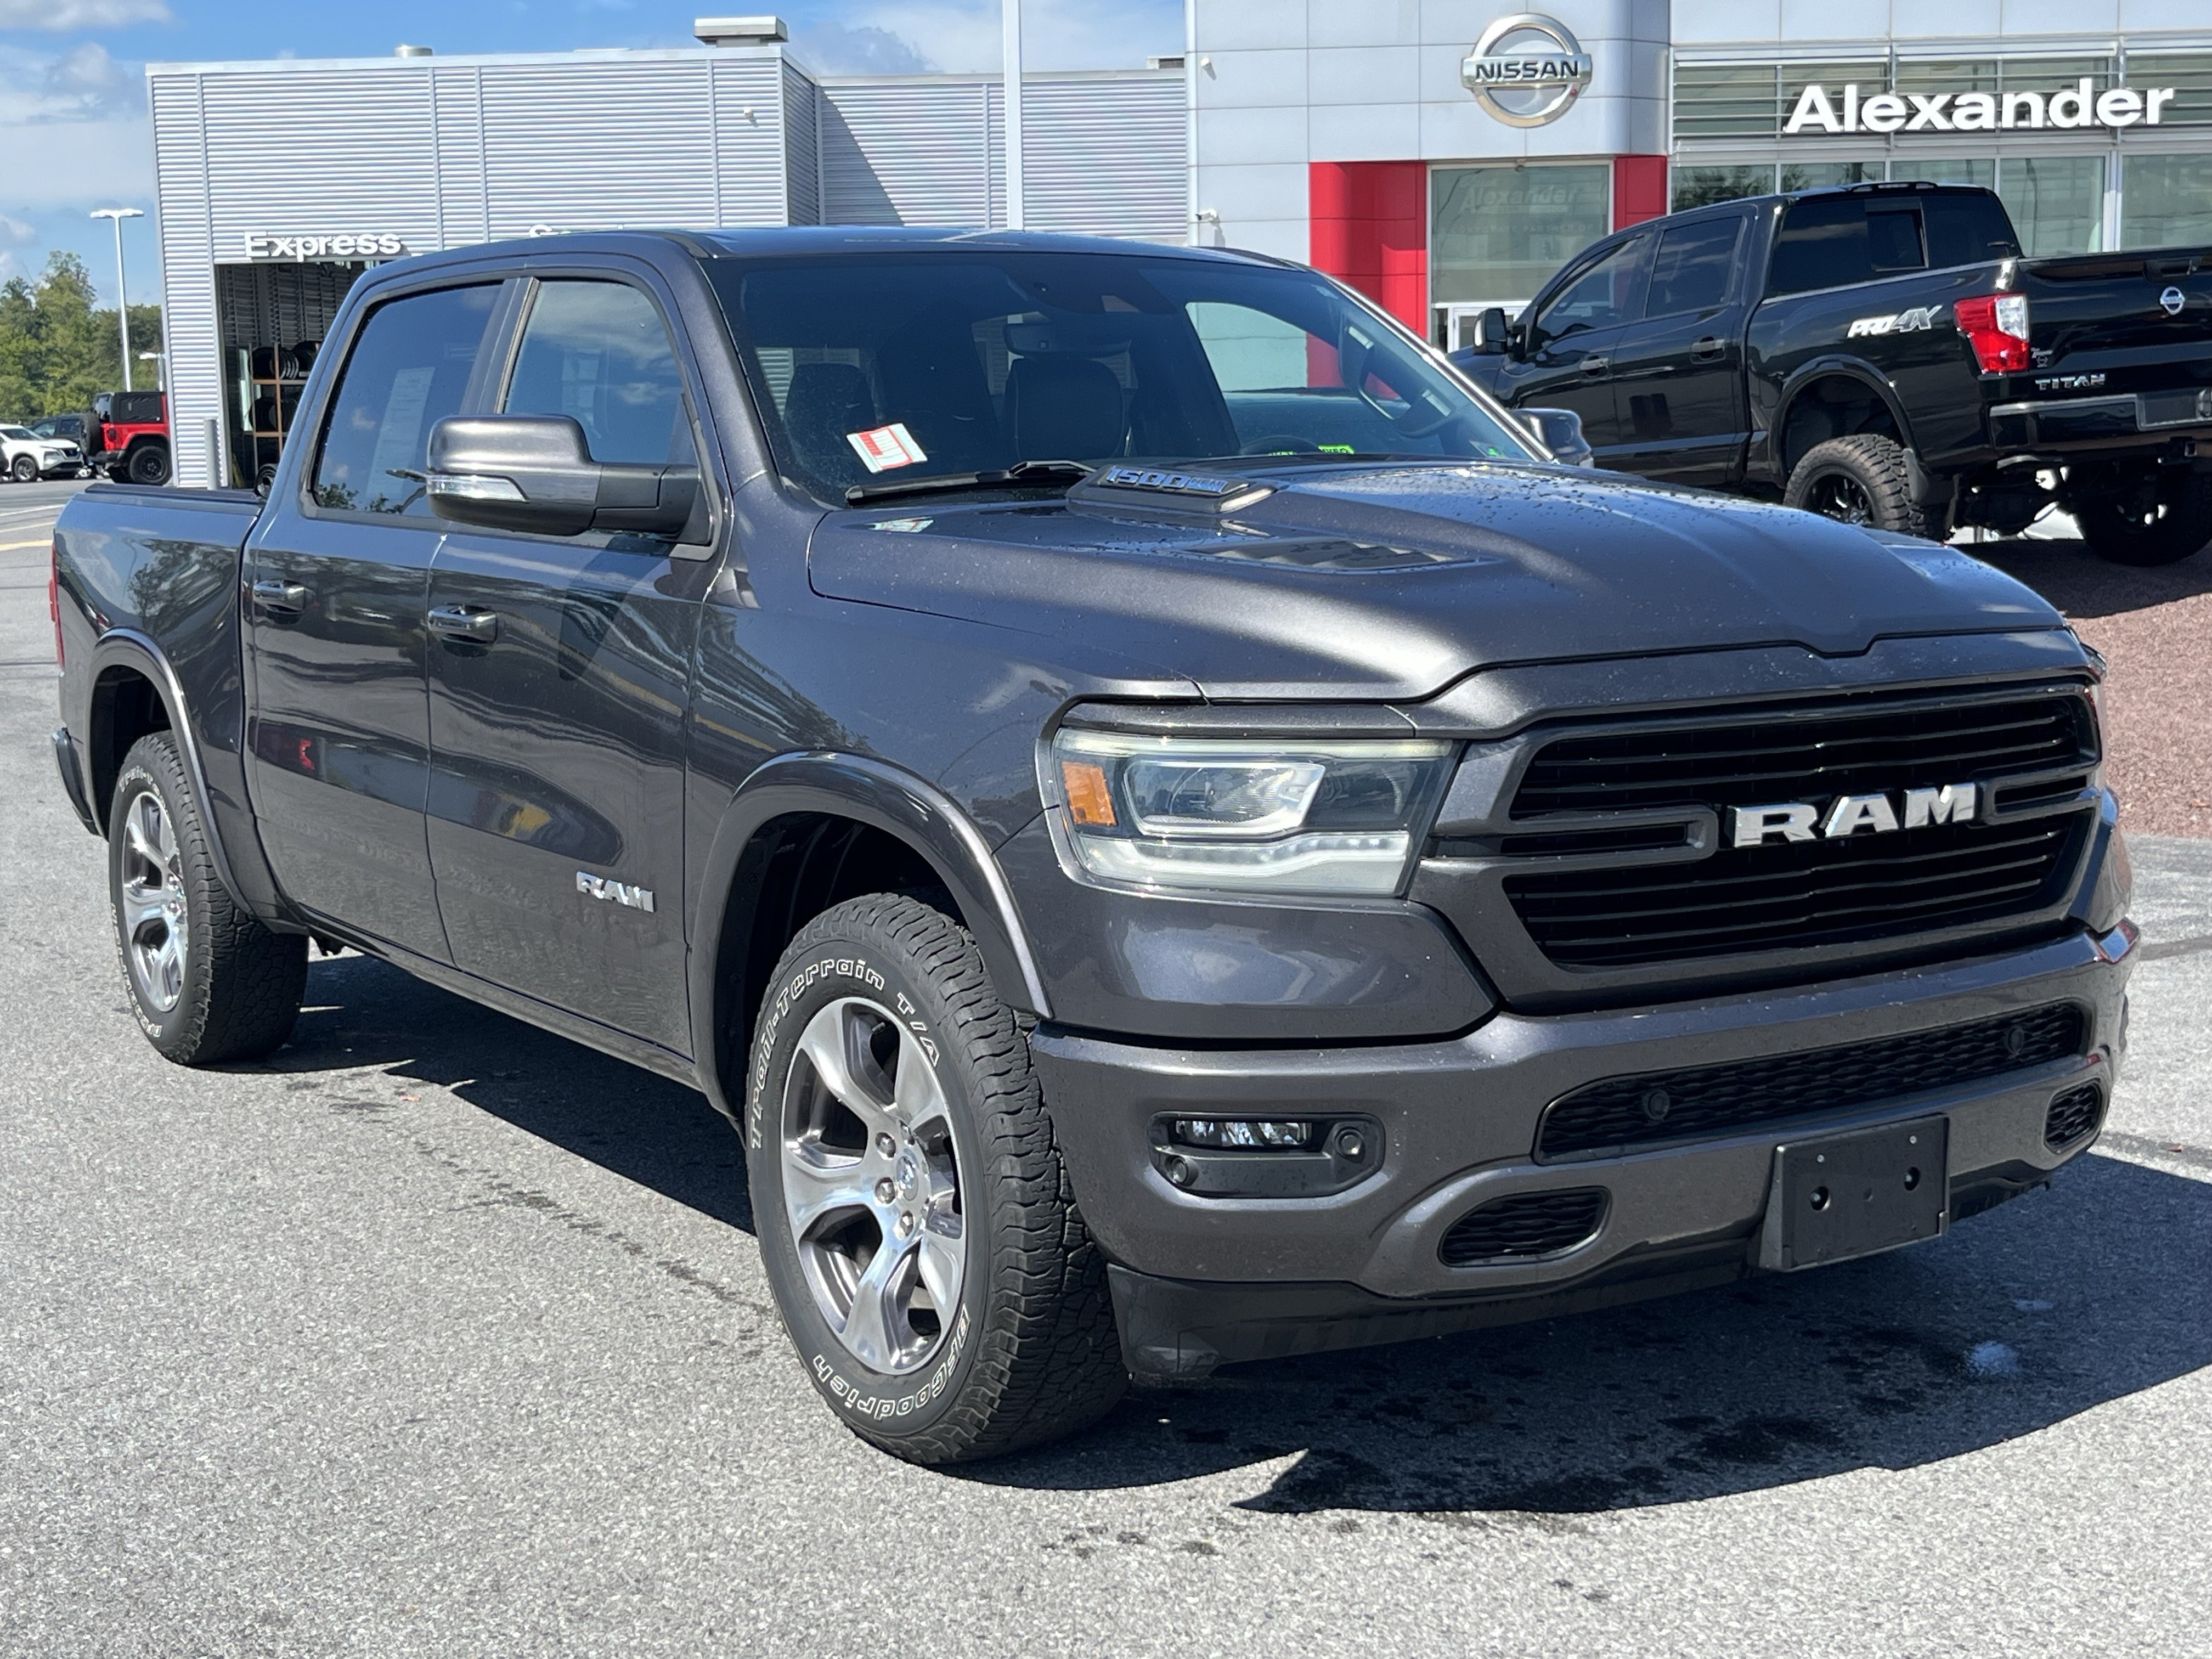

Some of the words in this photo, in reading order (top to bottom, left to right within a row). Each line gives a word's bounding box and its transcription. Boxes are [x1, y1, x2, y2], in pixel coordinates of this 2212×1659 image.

[1475, 60, 1578, 81] NISSAN
[1783, 78, 2175, 133] Alexander
[244, 231, 401, 262] Express
[2035, 374, 2105, 390] TITAN
[1105, 466, 1190, 489] 1500
[1728, 782, 1976, 848] RAM
[577, 871, 654, 913] RAM
[751, 959, 885, 1149] Trail-Terrain
[812, 1302, 970, 1421] BFGoodrich
